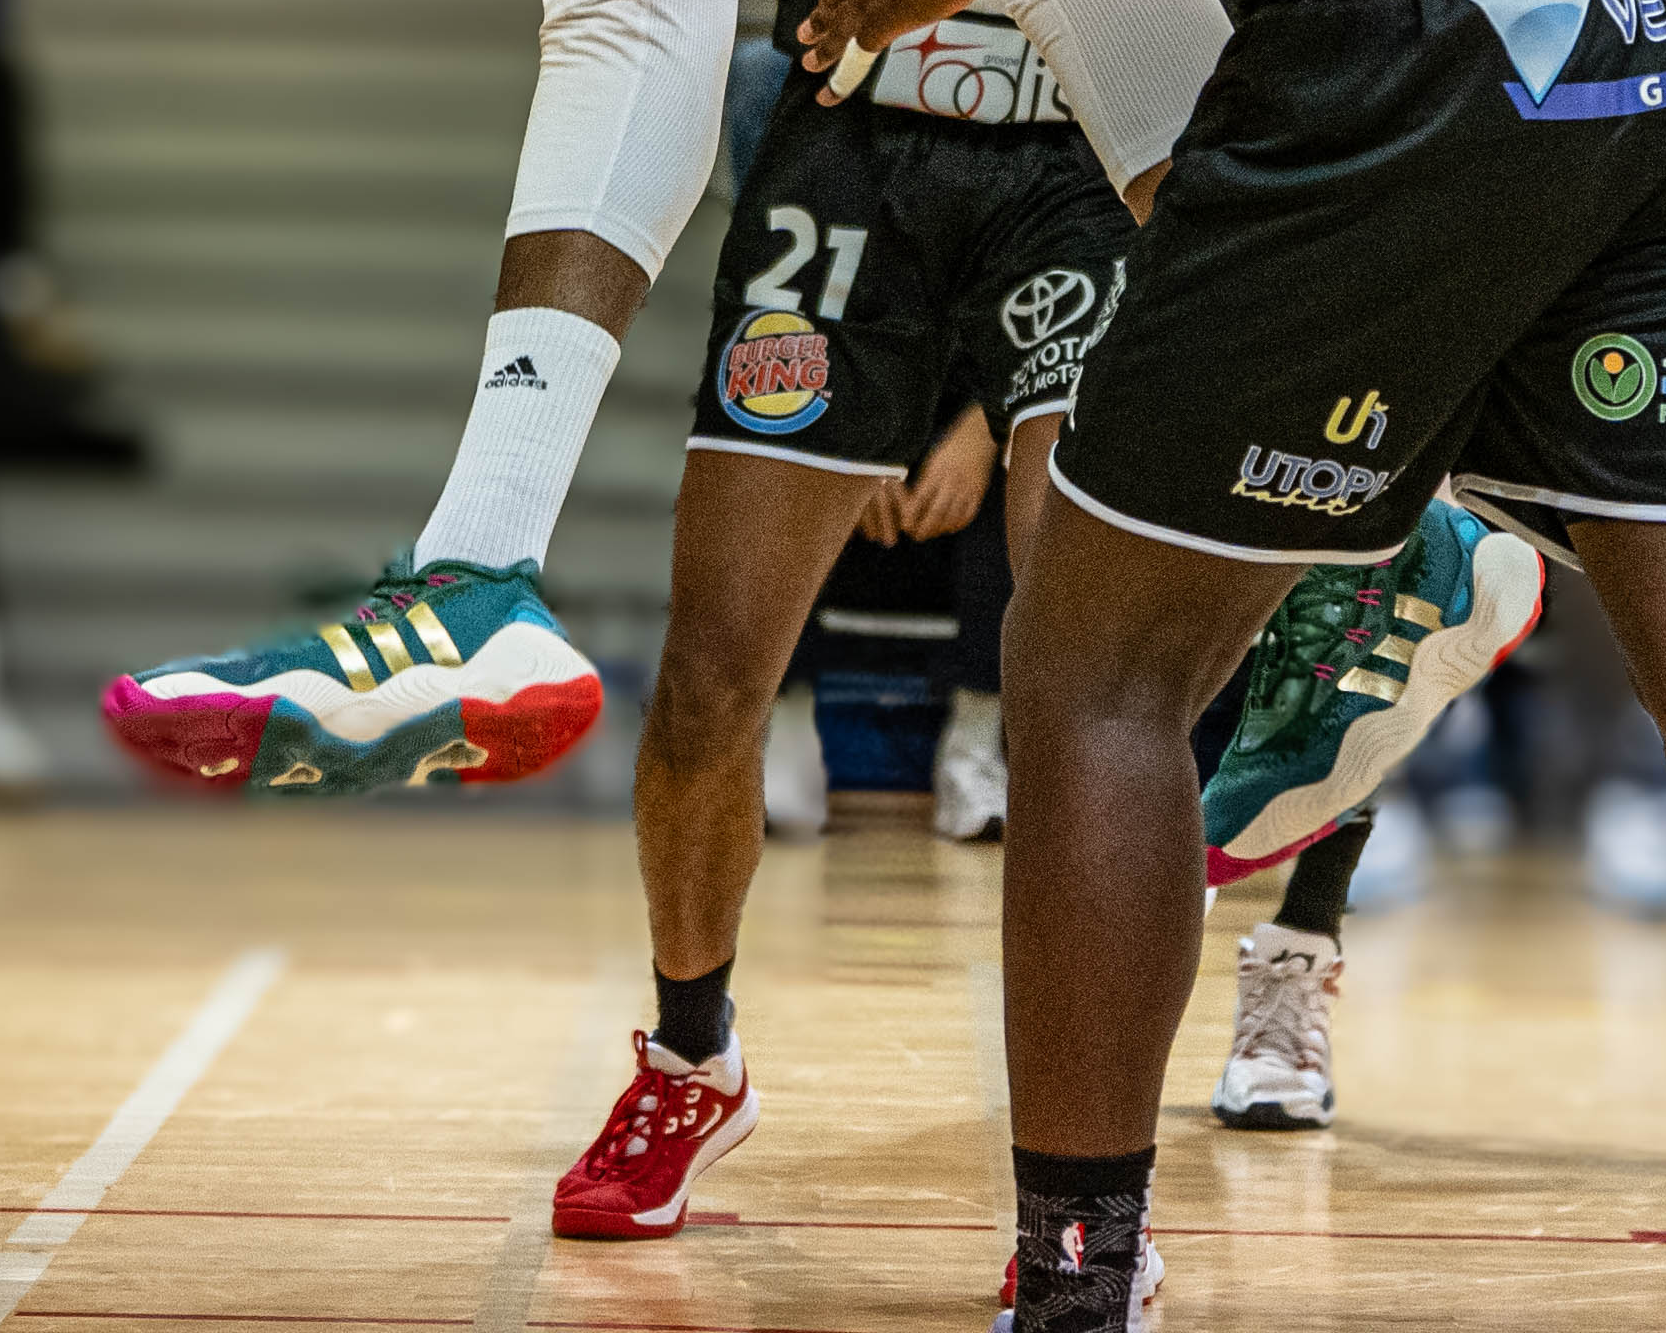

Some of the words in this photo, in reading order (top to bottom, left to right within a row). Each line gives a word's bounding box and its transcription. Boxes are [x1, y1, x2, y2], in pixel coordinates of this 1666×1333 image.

[744, 205, 869, 321] 21
[729, 335, 828, 371] BURGER
[485, 373, 548, 391] adidas
[726, 358, 830, 400] KING
